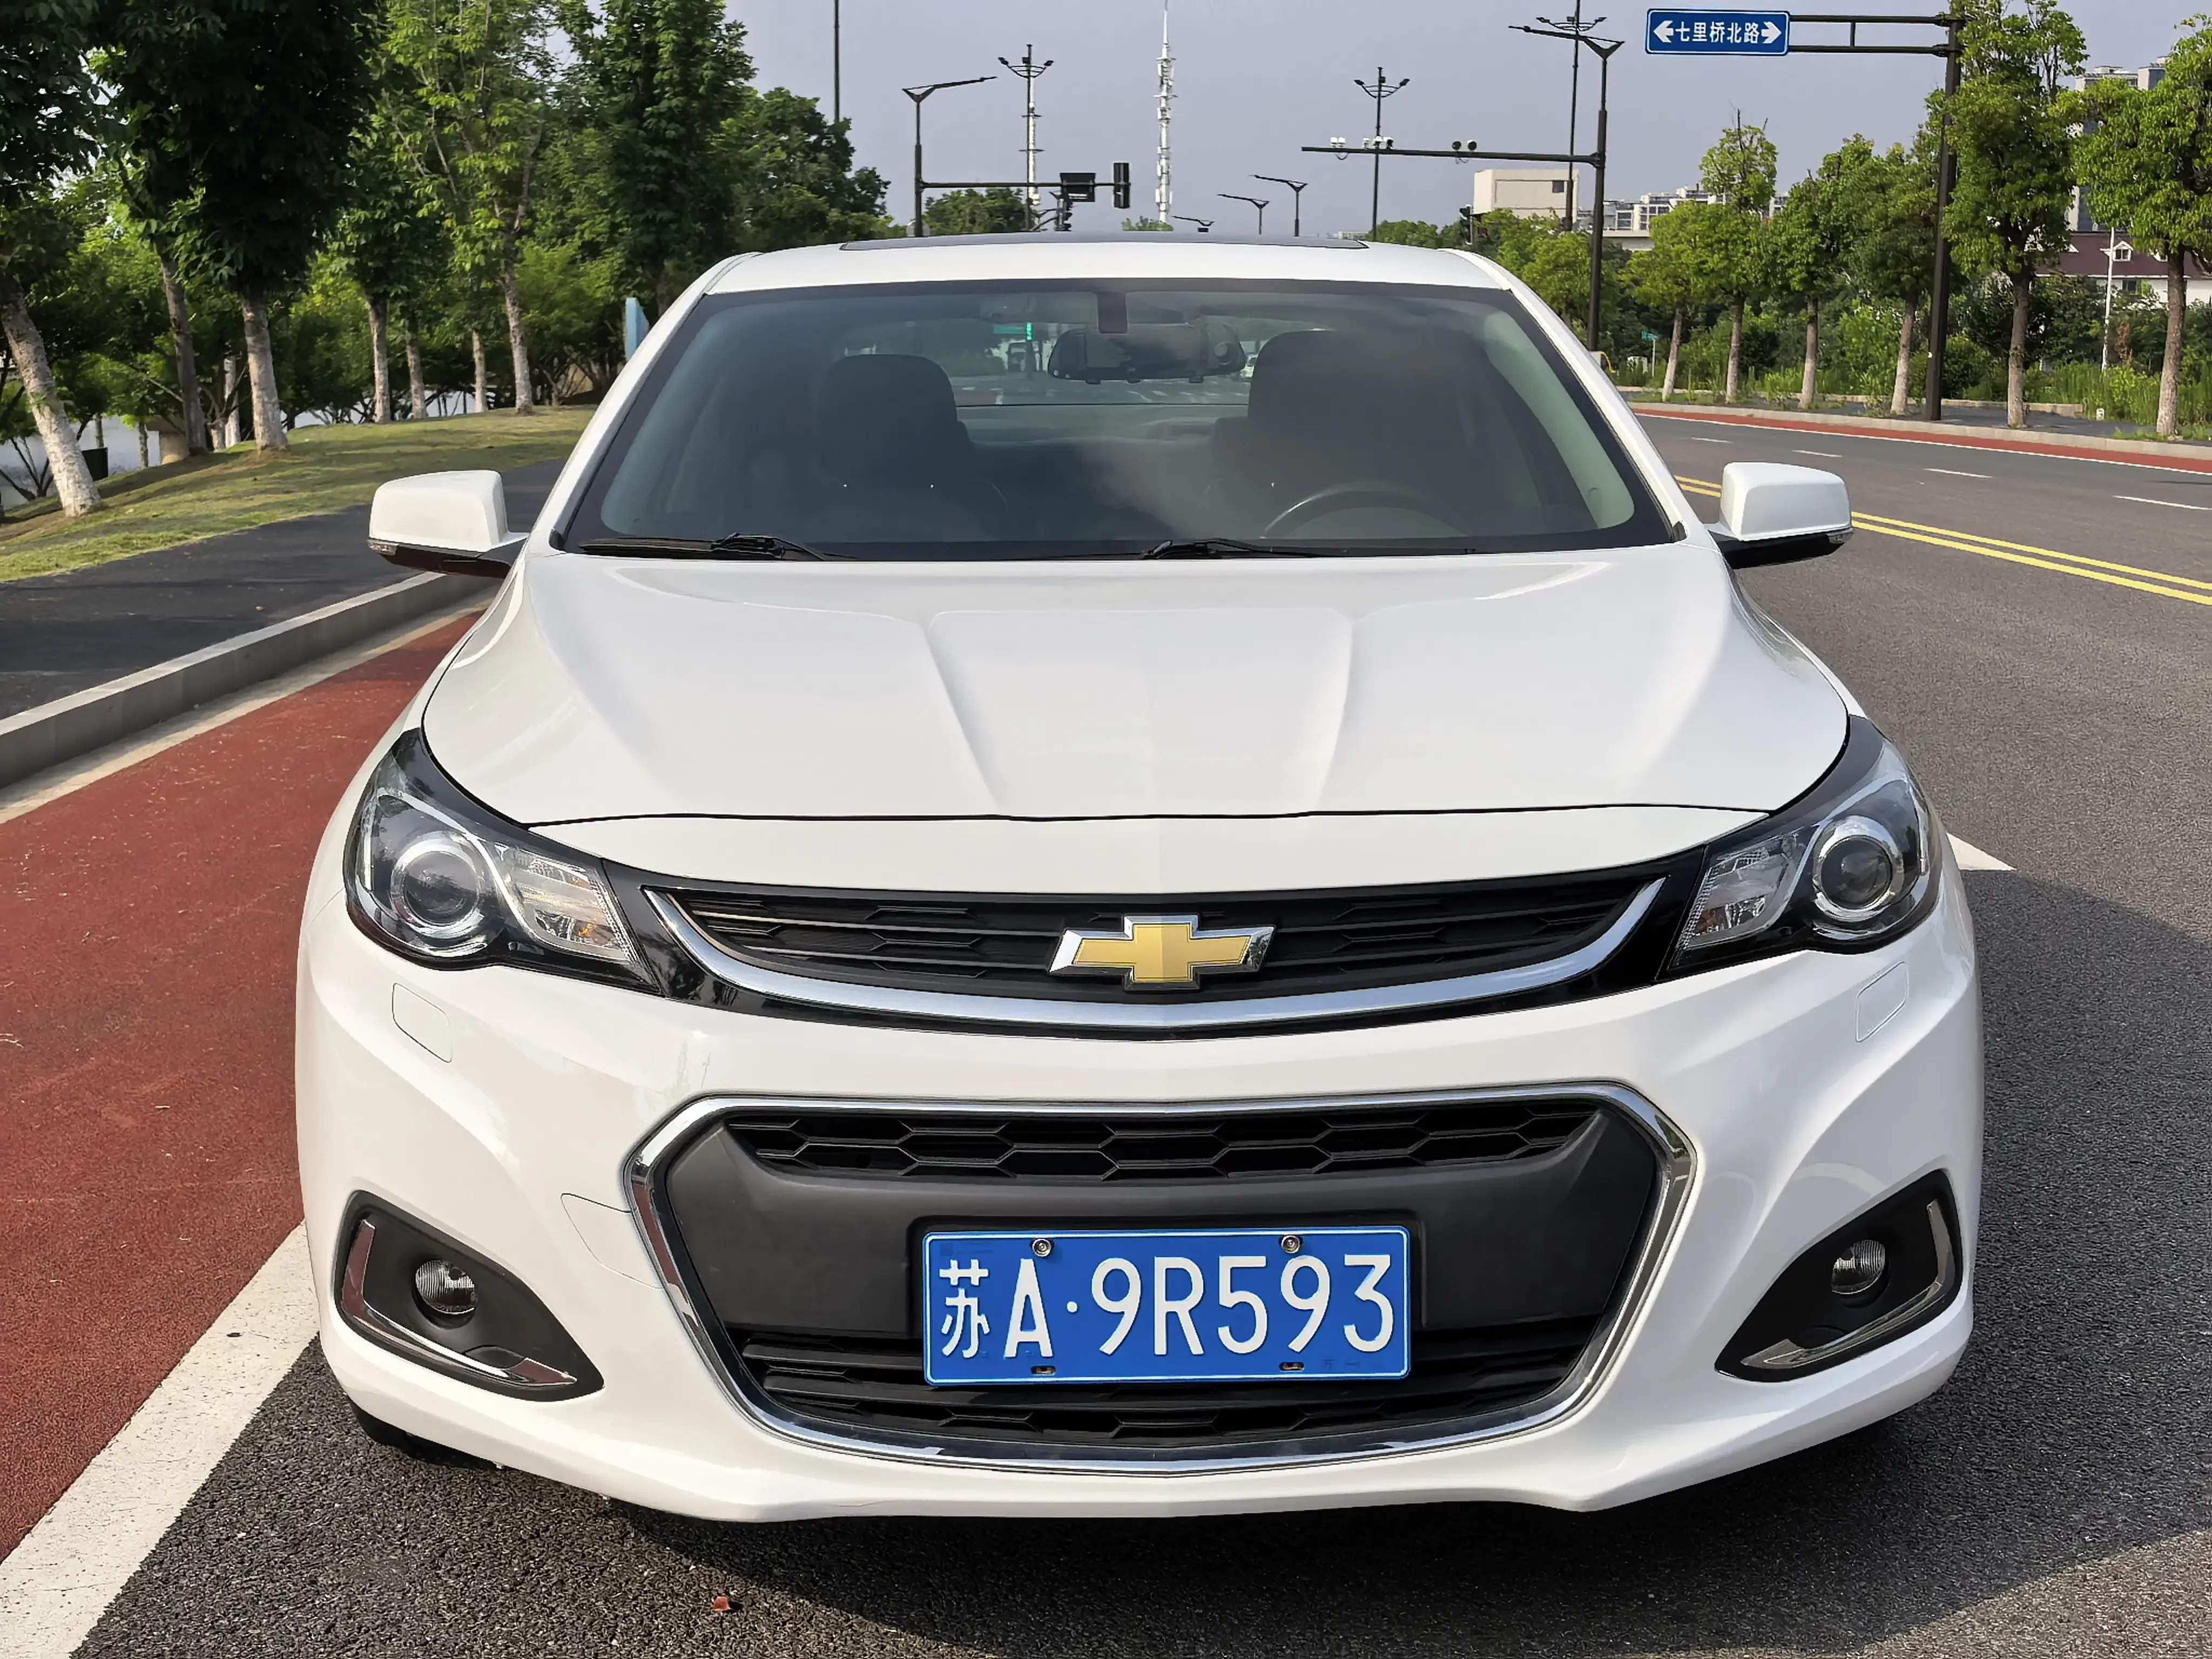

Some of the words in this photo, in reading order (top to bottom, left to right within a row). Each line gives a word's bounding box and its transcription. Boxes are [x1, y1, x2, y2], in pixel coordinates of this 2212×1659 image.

[1675, 22, 1759, 43] 七里桥北路
